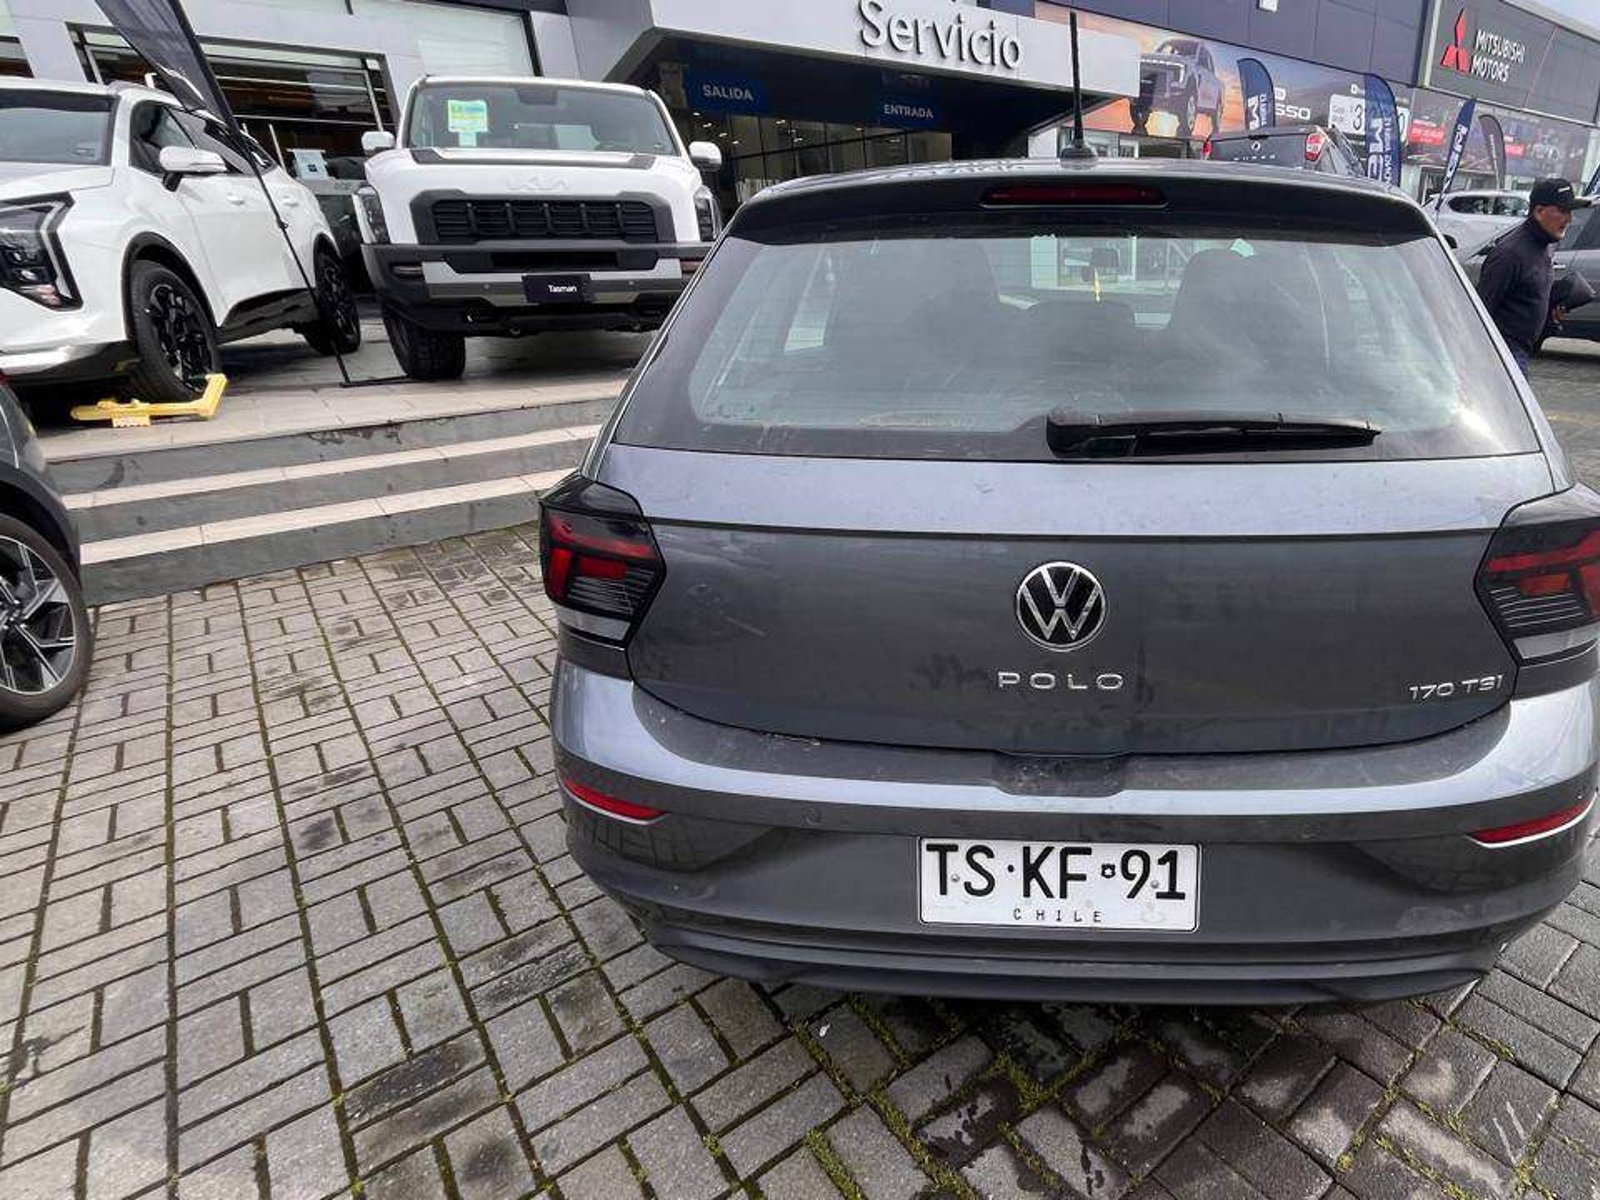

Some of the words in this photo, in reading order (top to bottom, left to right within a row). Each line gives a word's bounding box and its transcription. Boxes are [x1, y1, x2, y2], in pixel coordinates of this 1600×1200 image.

[858, 0, 1021, 69] Servicio
[1475, 29, 1525, 63] MITSUBISHI
[1471, 54, 1509, 82] MOTORS
[703, 84, 754, 101] SALIDA
[884, 104, 934, 119] ENTRADA
[1275, 103, 1311, 120] SSO
[547, 284, 578, 293] Tasman
[998, 671, 1124, 690] POLO
[1409, 682, 1454, 700] 170
[1461, 674, 1503, 693] TSI
[1013, 907, 1102, 923] CHILE
